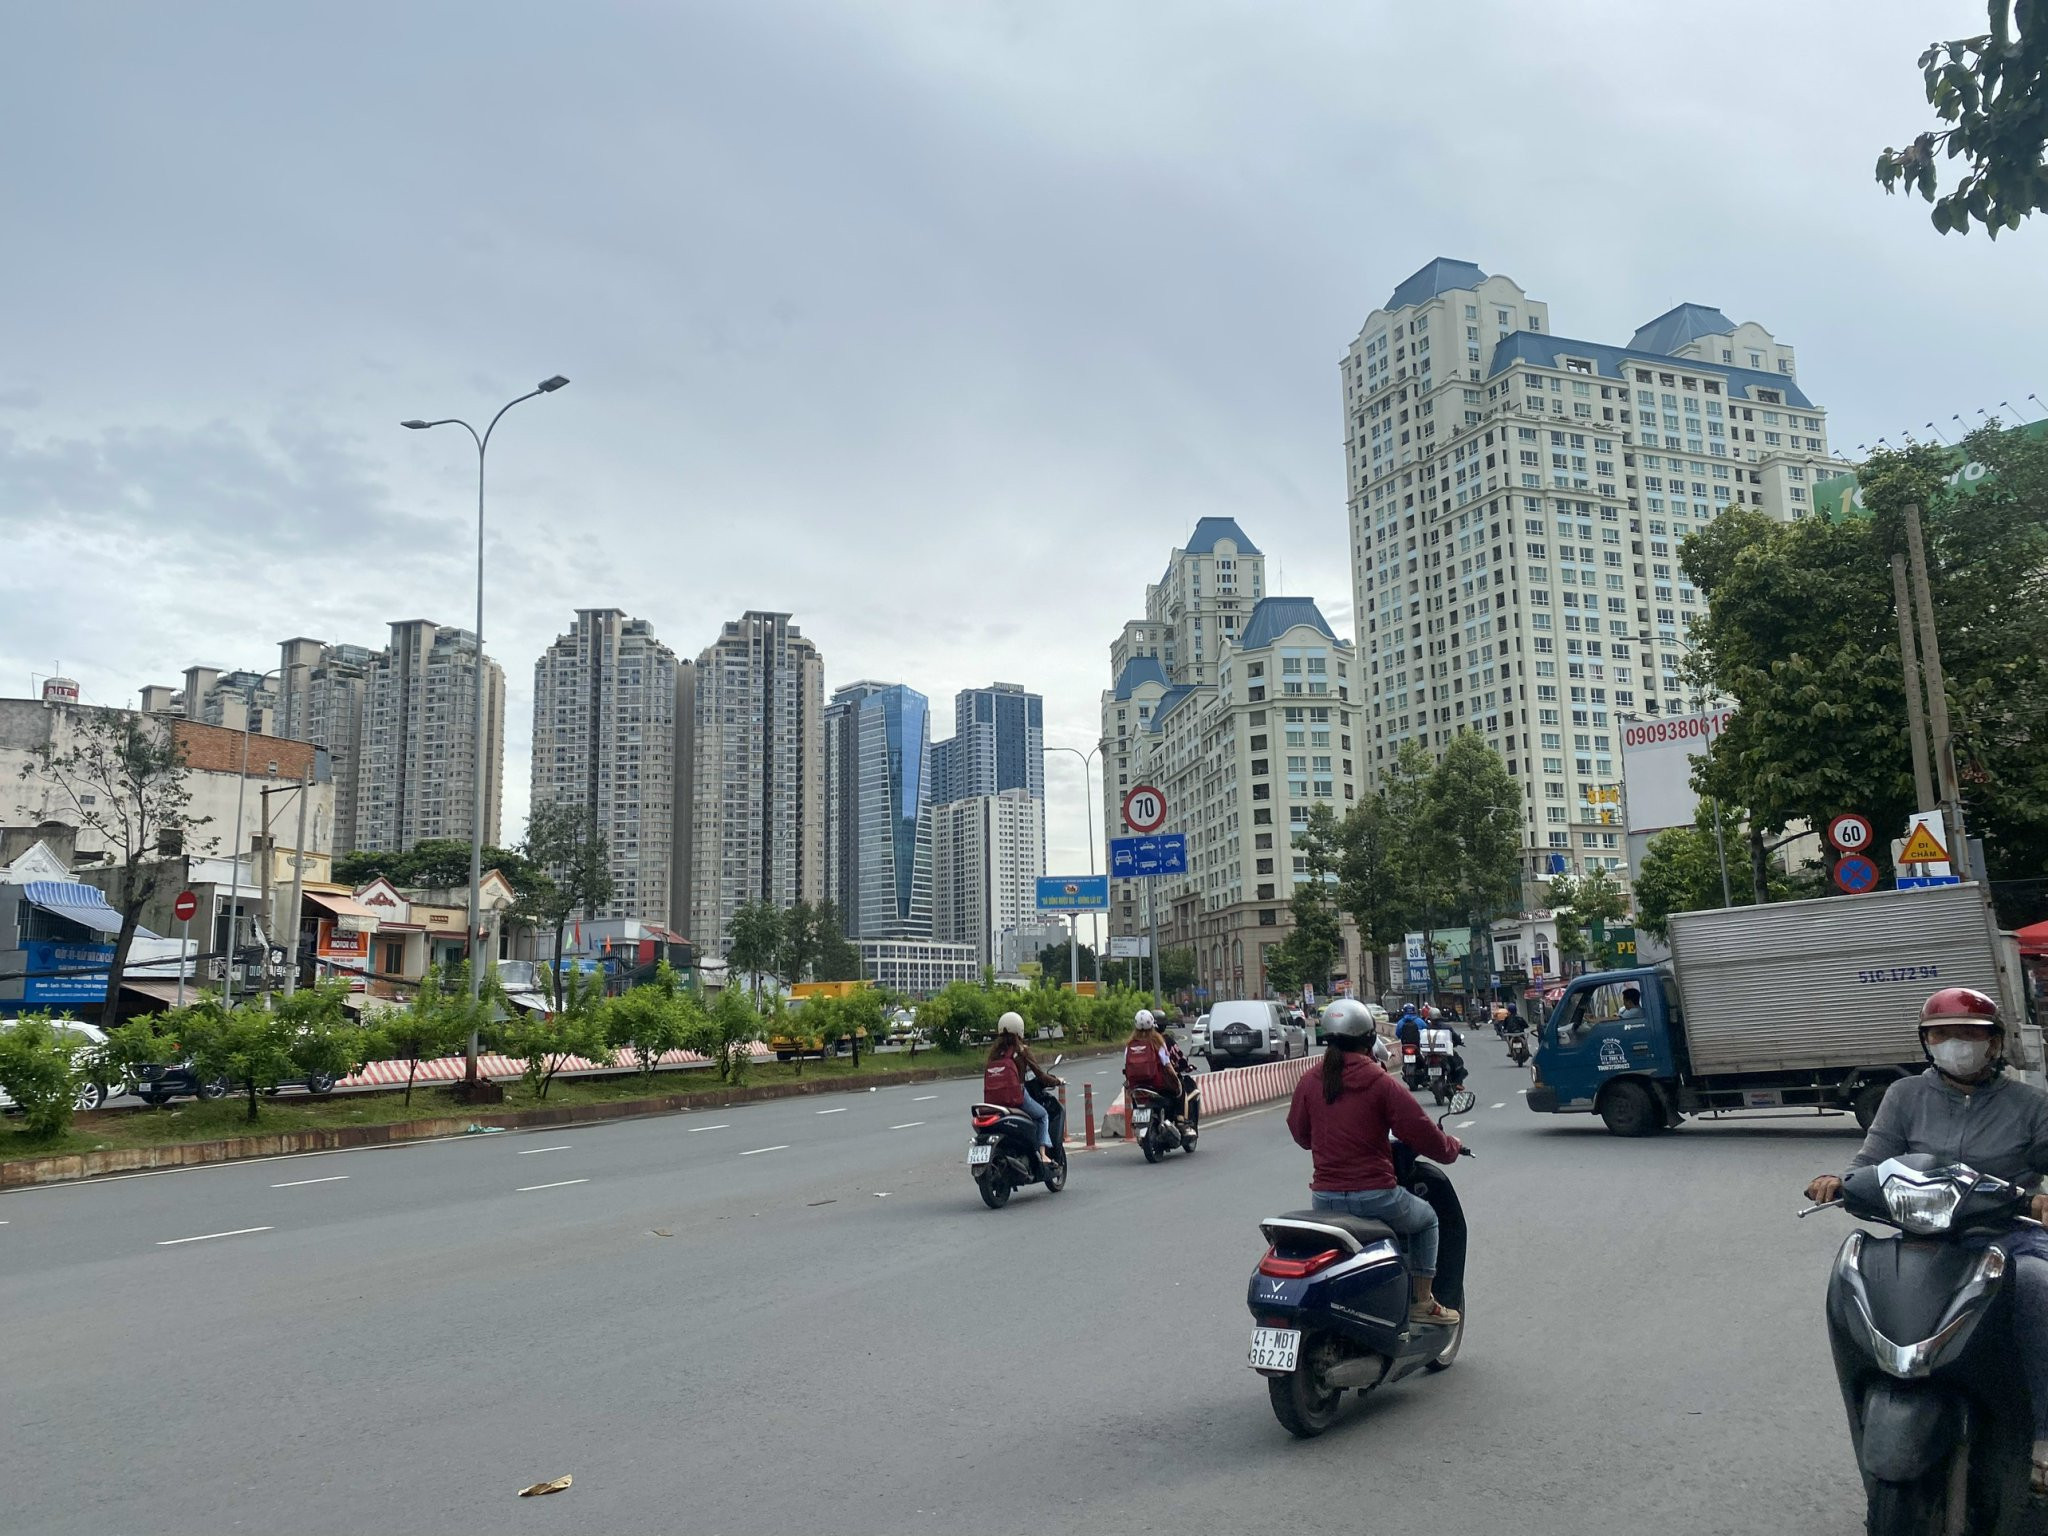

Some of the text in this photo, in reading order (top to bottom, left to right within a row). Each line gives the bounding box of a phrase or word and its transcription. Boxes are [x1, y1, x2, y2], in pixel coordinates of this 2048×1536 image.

[1626, 713, 1731, 746] 0909380618
[1136, 797, 1155, 819] 70
[1842, 825, 1861, 843] 60
[1250, 1350, 1294, 1369] 362.28
